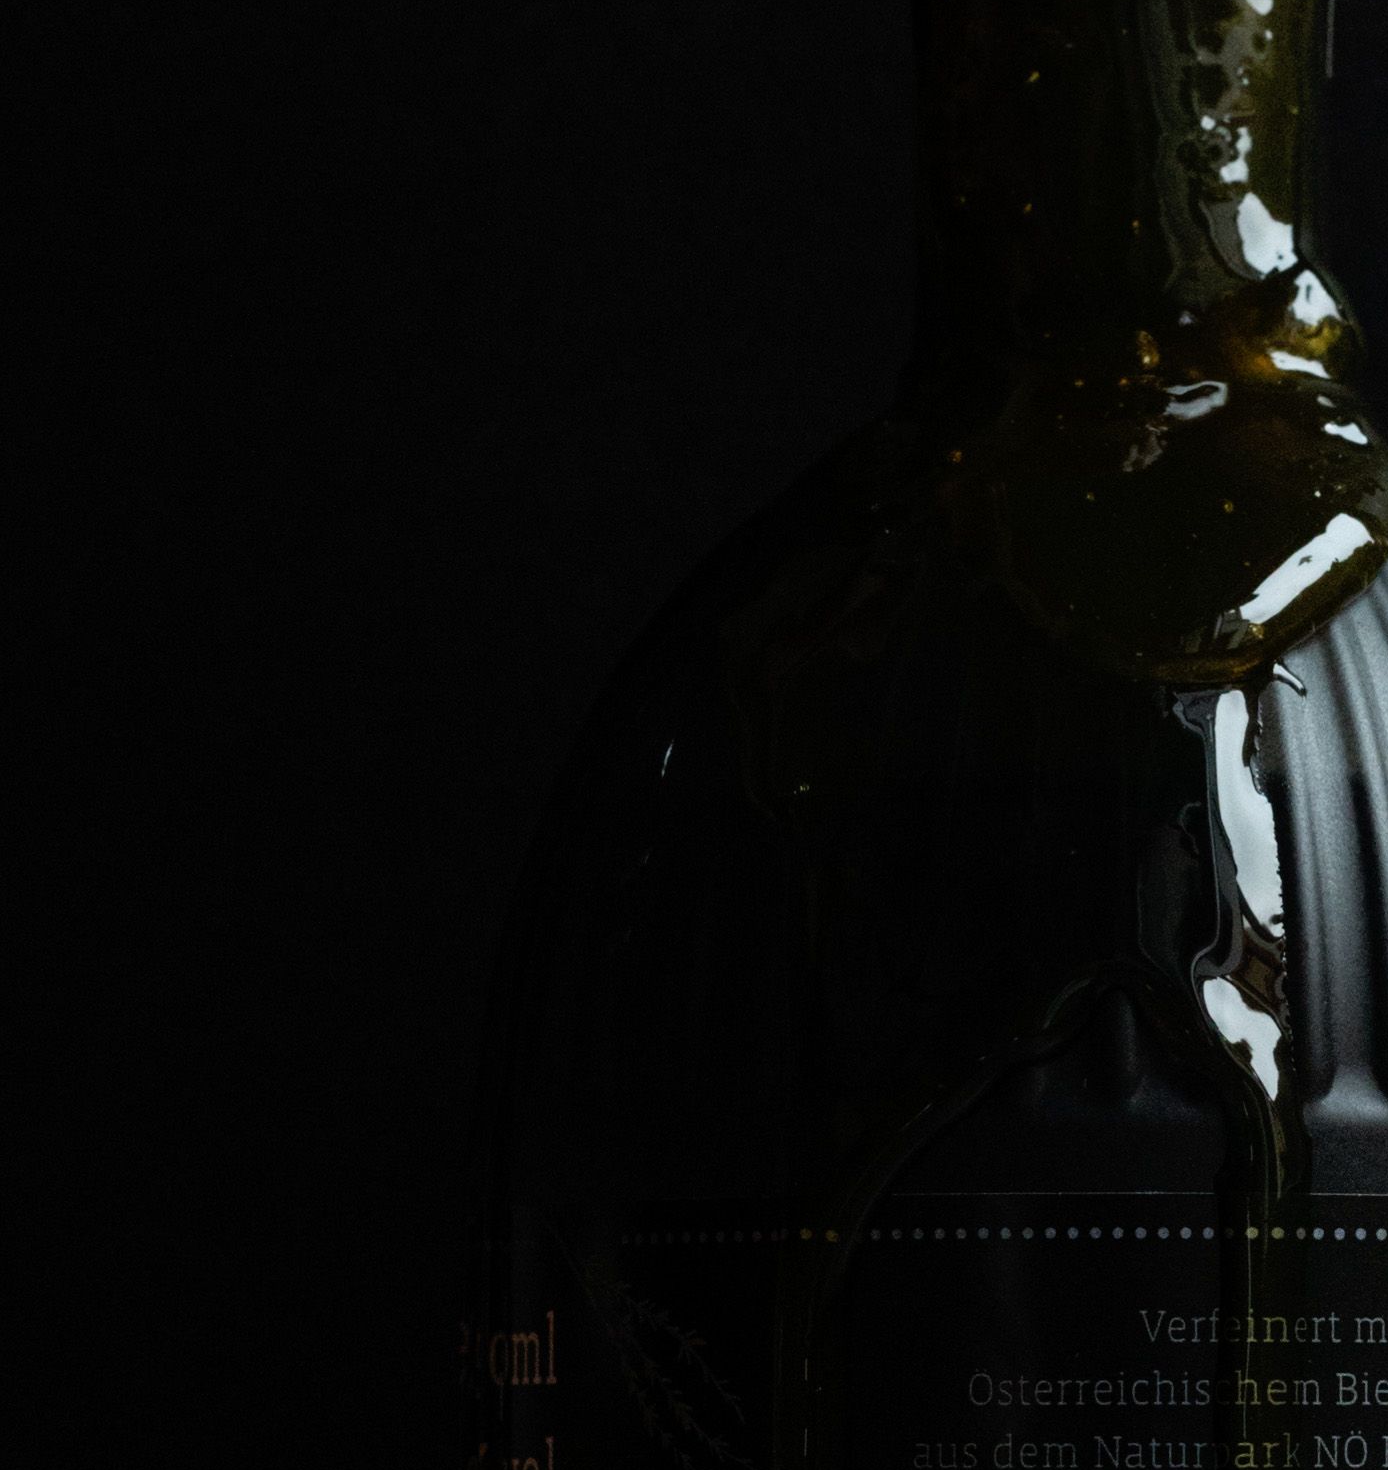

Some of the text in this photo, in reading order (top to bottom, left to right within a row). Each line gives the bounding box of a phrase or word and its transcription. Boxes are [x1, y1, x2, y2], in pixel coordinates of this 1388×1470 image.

[1139, 1308, 1341, 1345] Verfeinert
[967, 1369, 1323, 1407] Österreichischem
[912, 1441, 979, 1470] aus
[992, 1433, 1079, 1470] dem
[1313, 1427, 1369, 1470] NÖ
